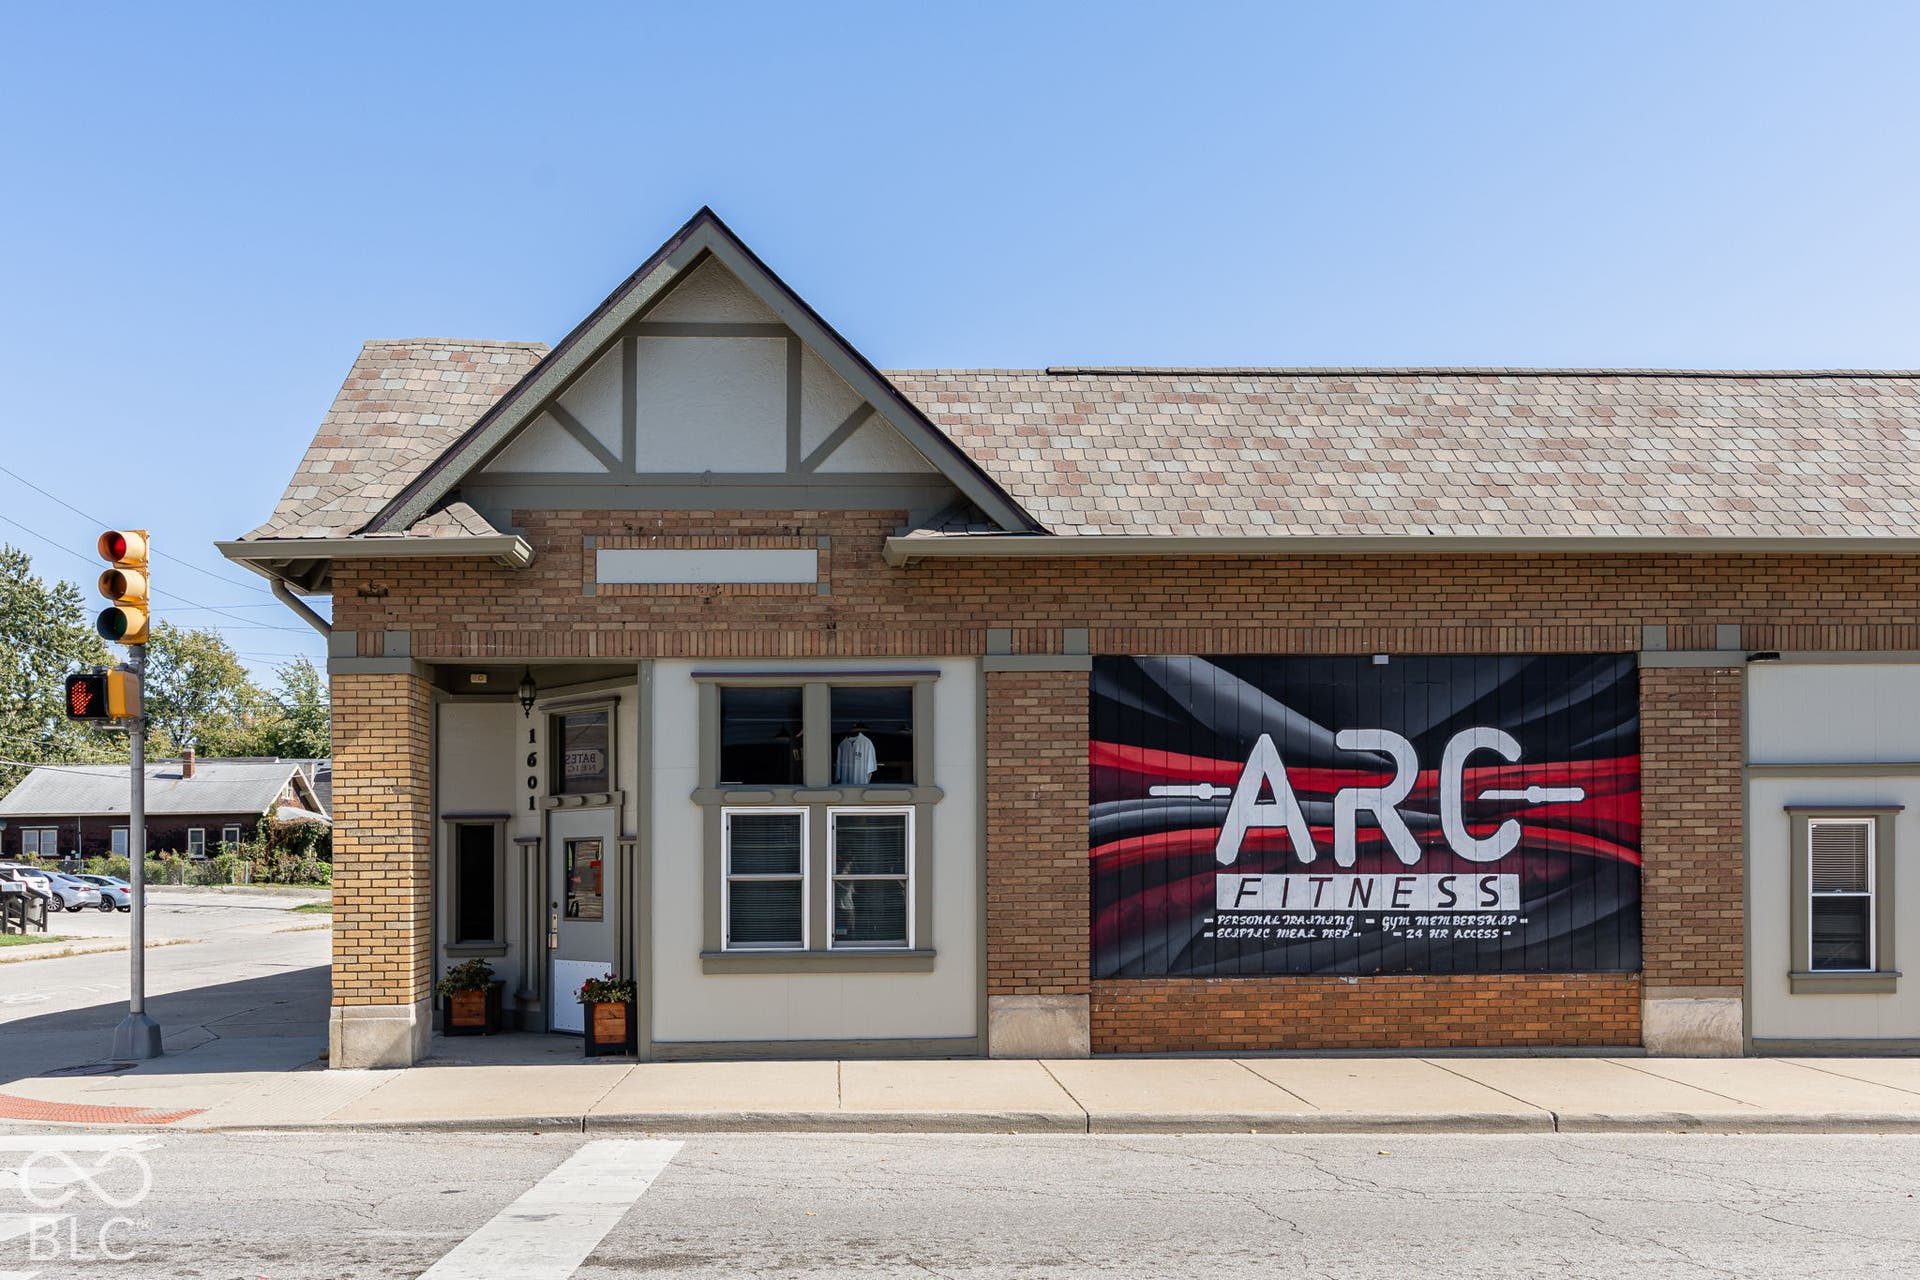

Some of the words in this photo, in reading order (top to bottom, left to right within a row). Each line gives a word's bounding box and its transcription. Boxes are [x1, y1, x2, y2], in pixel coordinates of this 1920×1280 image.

[526, 728, 538, 811] 1601
[1216, 727, 1522, 867] ARC
[1234, 875, 1500, 908] FITNESS
[1217, 914, 1280, 925] PERSONAL
[1282, 915, 1355, 931] TRAINING
[1381, 916, 1411, 931] GYM
[1415, 915, 1518, 926] MEMBERSHIP
[1276, 928, 1318, 938] MEAL
[1322, 928, 1350, 938] PREP
[1406, 928, 1423, 938] 24
[1429, 928, 1449, 938] HR
[1453, 928, 1500, 938] ACCESS
